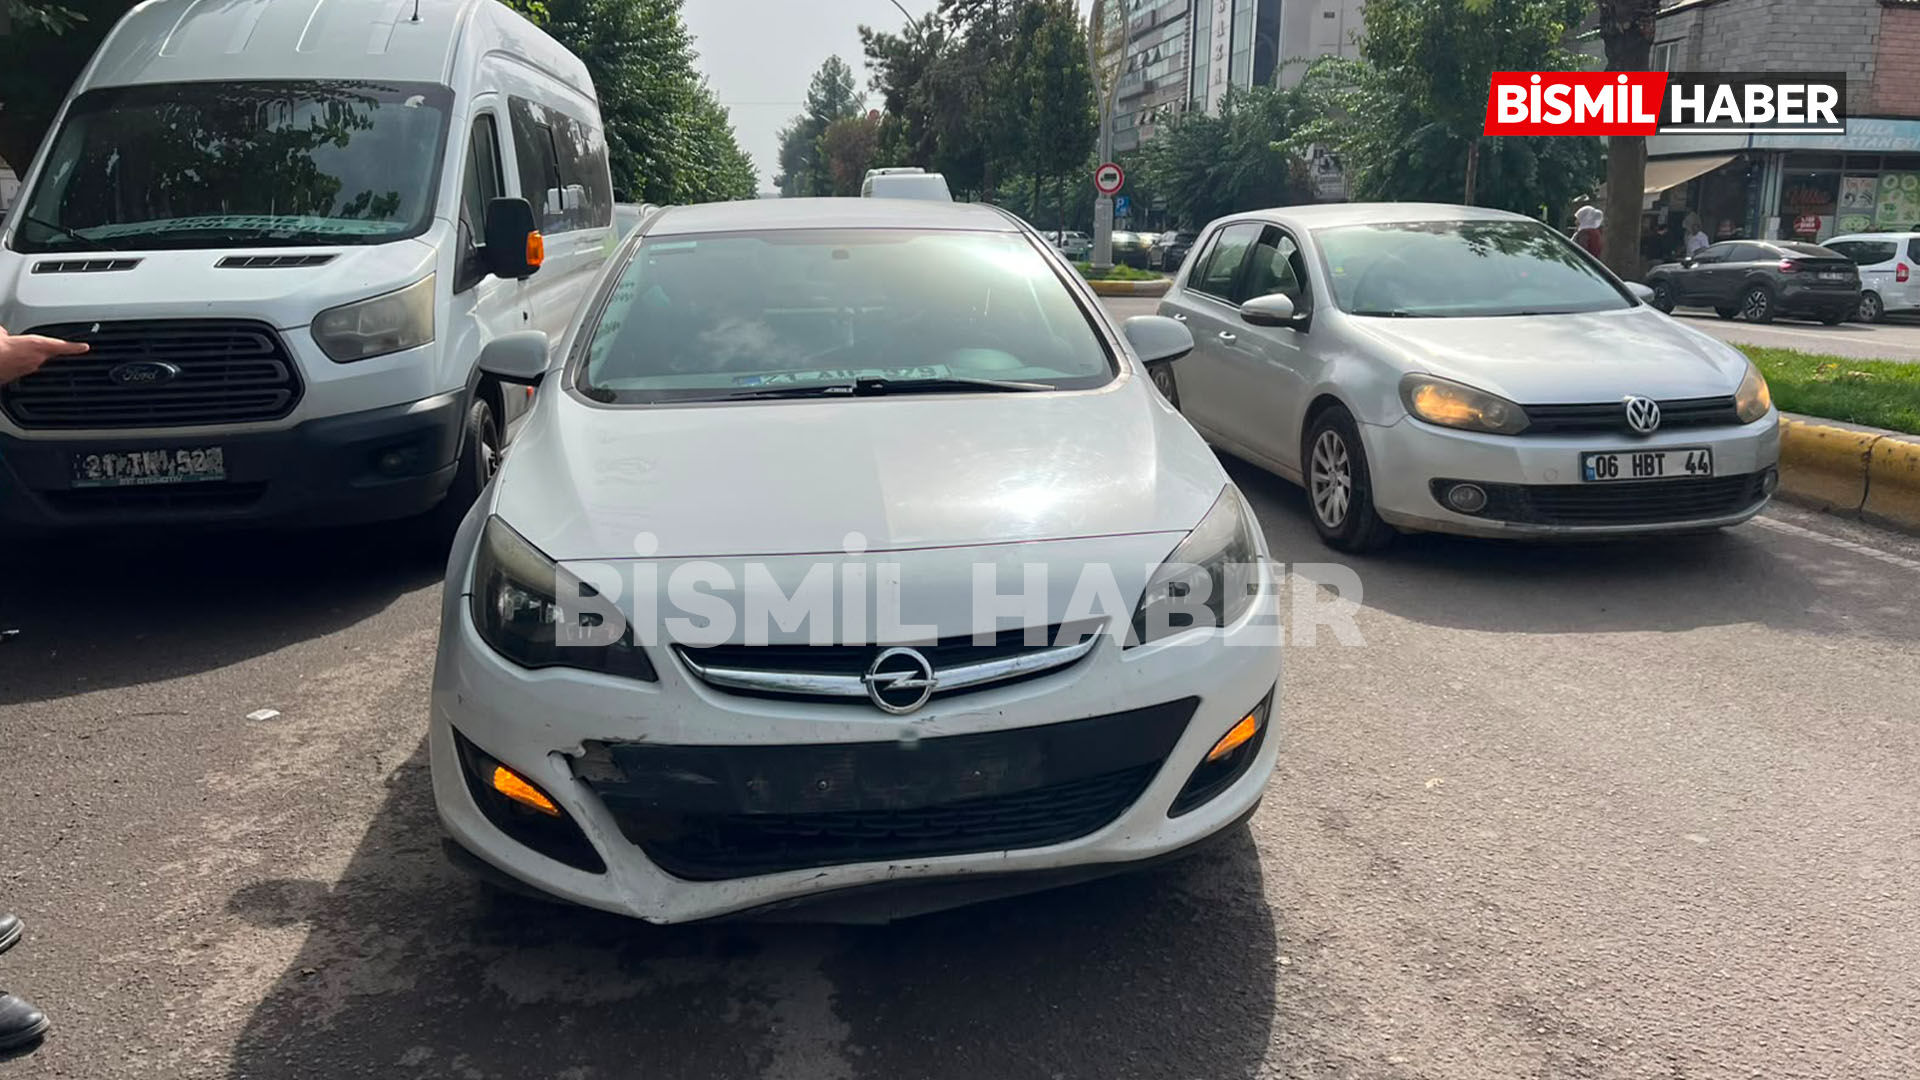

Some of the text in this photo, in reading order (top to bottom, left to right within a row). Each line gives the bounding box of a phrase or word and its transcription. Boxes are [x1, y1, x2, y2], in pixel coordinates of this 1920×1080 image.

[1116, 197, 1125, 209] P
[121, 367, 160, 382] Ford
[1596, 451, 1709, 478] 06 HBT 44
